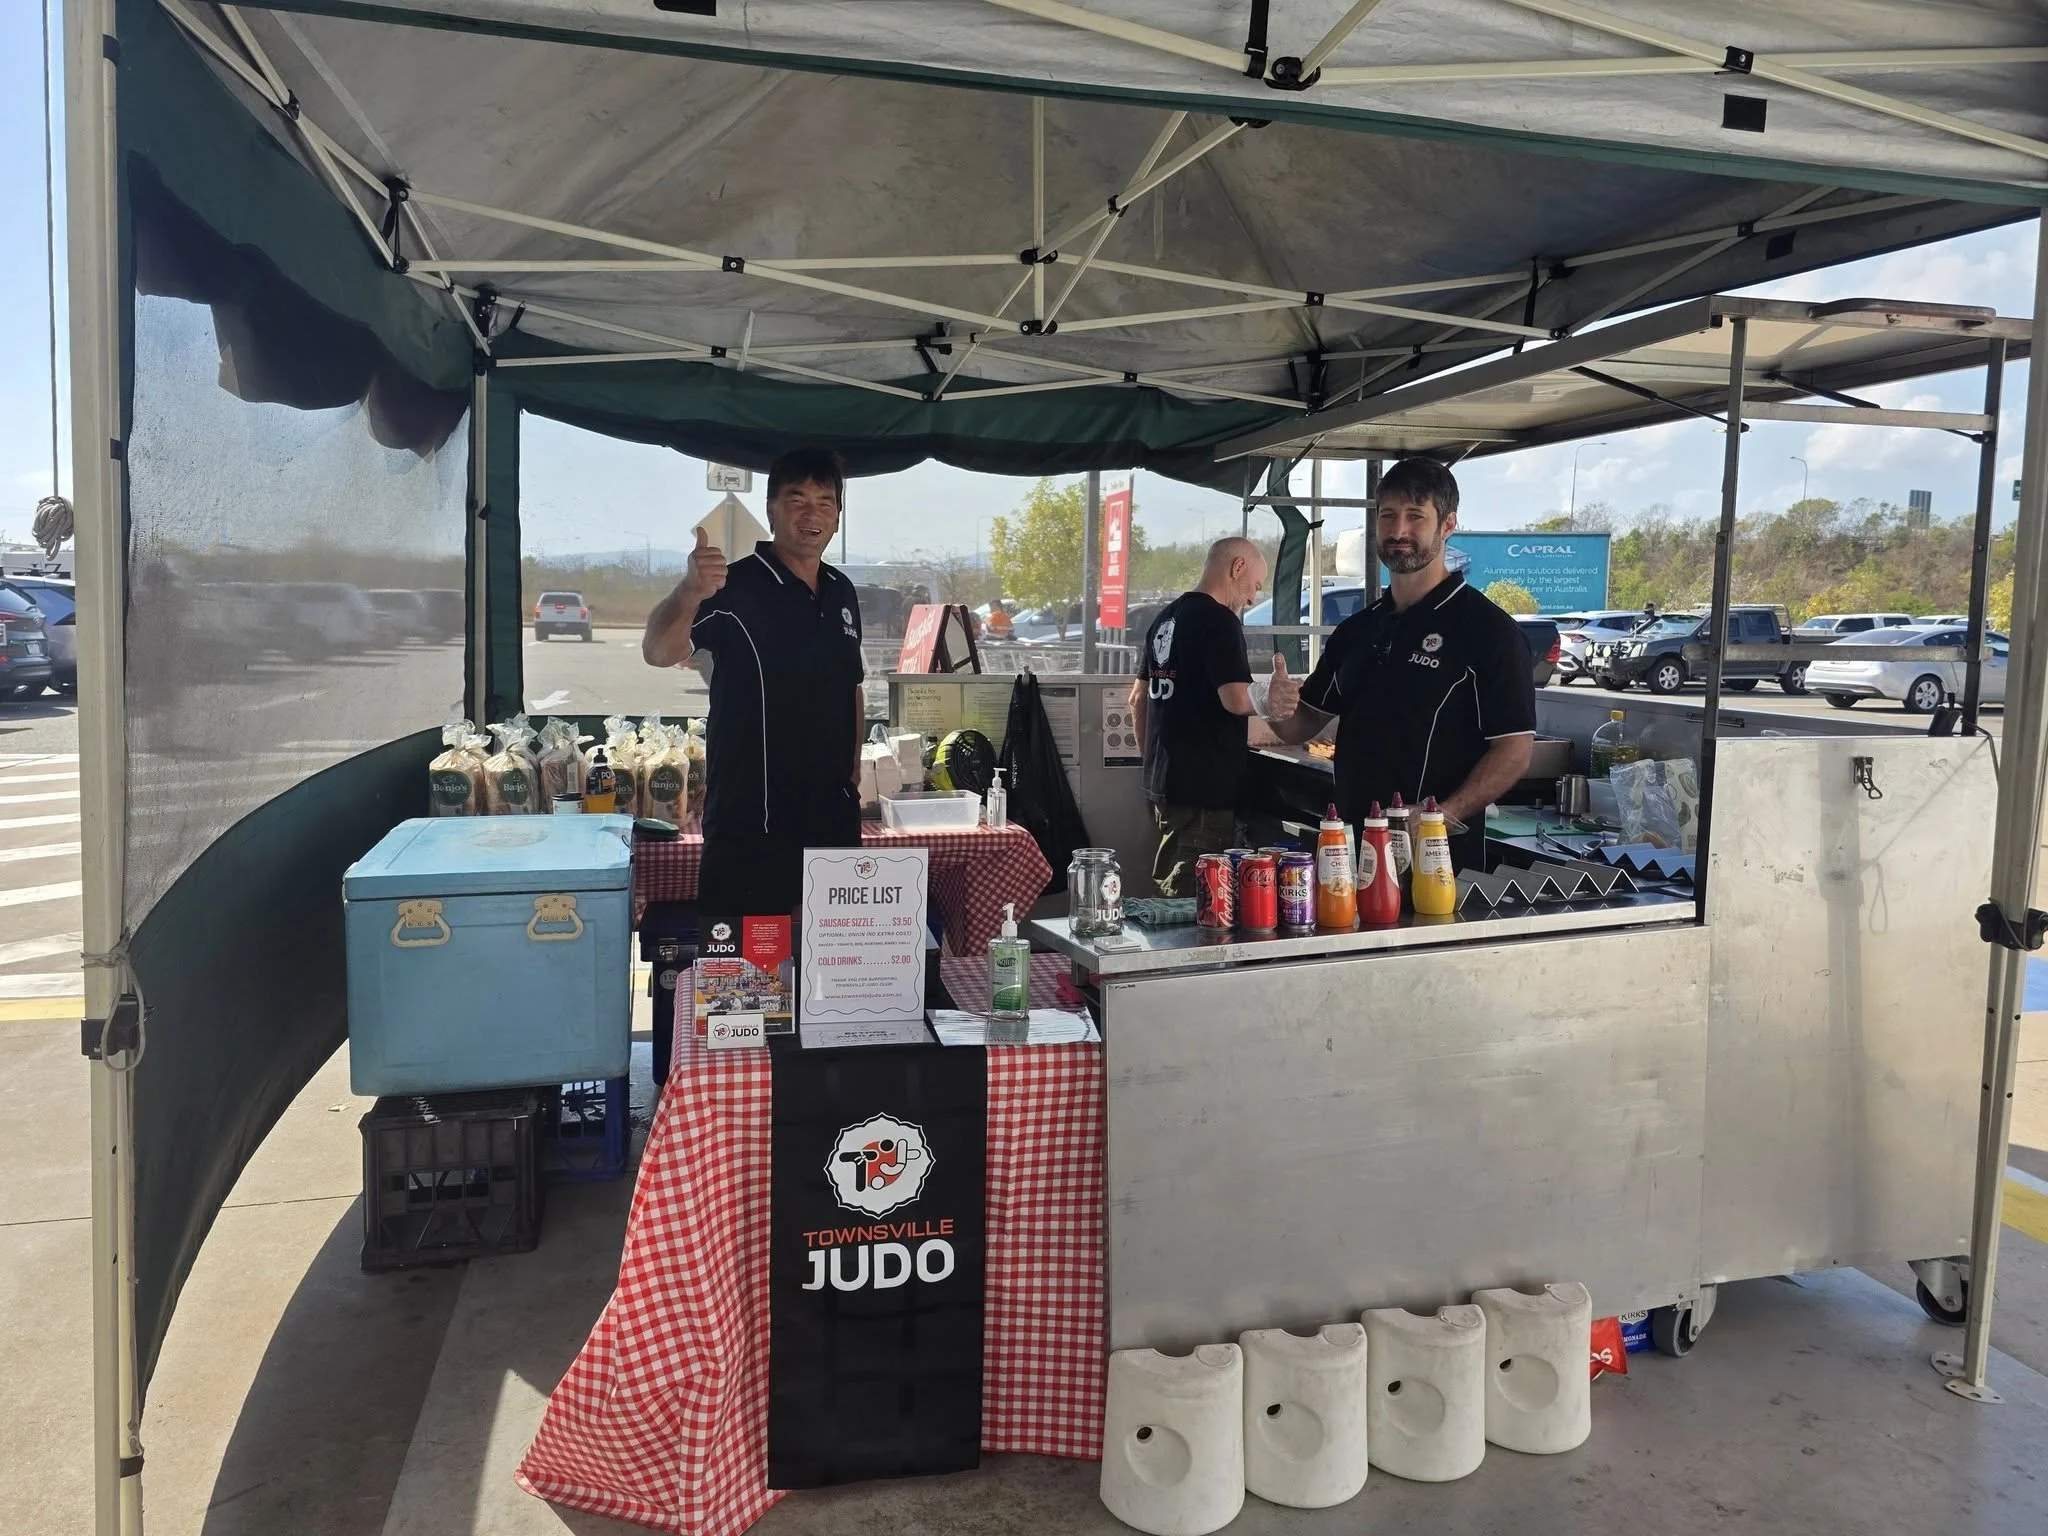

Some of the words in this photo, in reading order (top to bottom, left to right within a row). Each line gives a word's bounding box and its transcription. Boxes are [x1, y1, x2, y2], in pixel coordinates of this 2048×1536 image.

[1507, 544, 1576, 557] CAPRAL
[1483, 567, 1525, 575] Aluminium
[1527, 567, 1561, 575] solutions
[1562, 567, 1598, 575] delivered
[1527, 577, 1538, 585] by
[1554, 577, 1580, 585] largest
[1408, 653, 1440, 669] JUDO
[432, 783, 468, 793] Banjo's
[651, 780, 680, 790] Banjo's
[828, 887, 869, 905] PRICE
[873, 886, 903, 904] LIST
[1279, 887, 1308, 897] KIRKS
[818, 918, 851, 928] SAUSAGE
[851, 917, 875, 927] SIZZLE
[892, 916, 912, 926] $3.50
[706, 944, 736, 953] JUDO
[818, 957, 837, 966] COLD
[837, 956, 863, 966] DRINKS
[891, 955, 911, 965] $2.00
[731, 1028, 759, 1037] JUDO
[803, 1219, 954, 1247] TOWNSVILLE
[801, 1238, 955, 1292] JUDO
[1621, 1310, 1647, 1320] KIRKS
